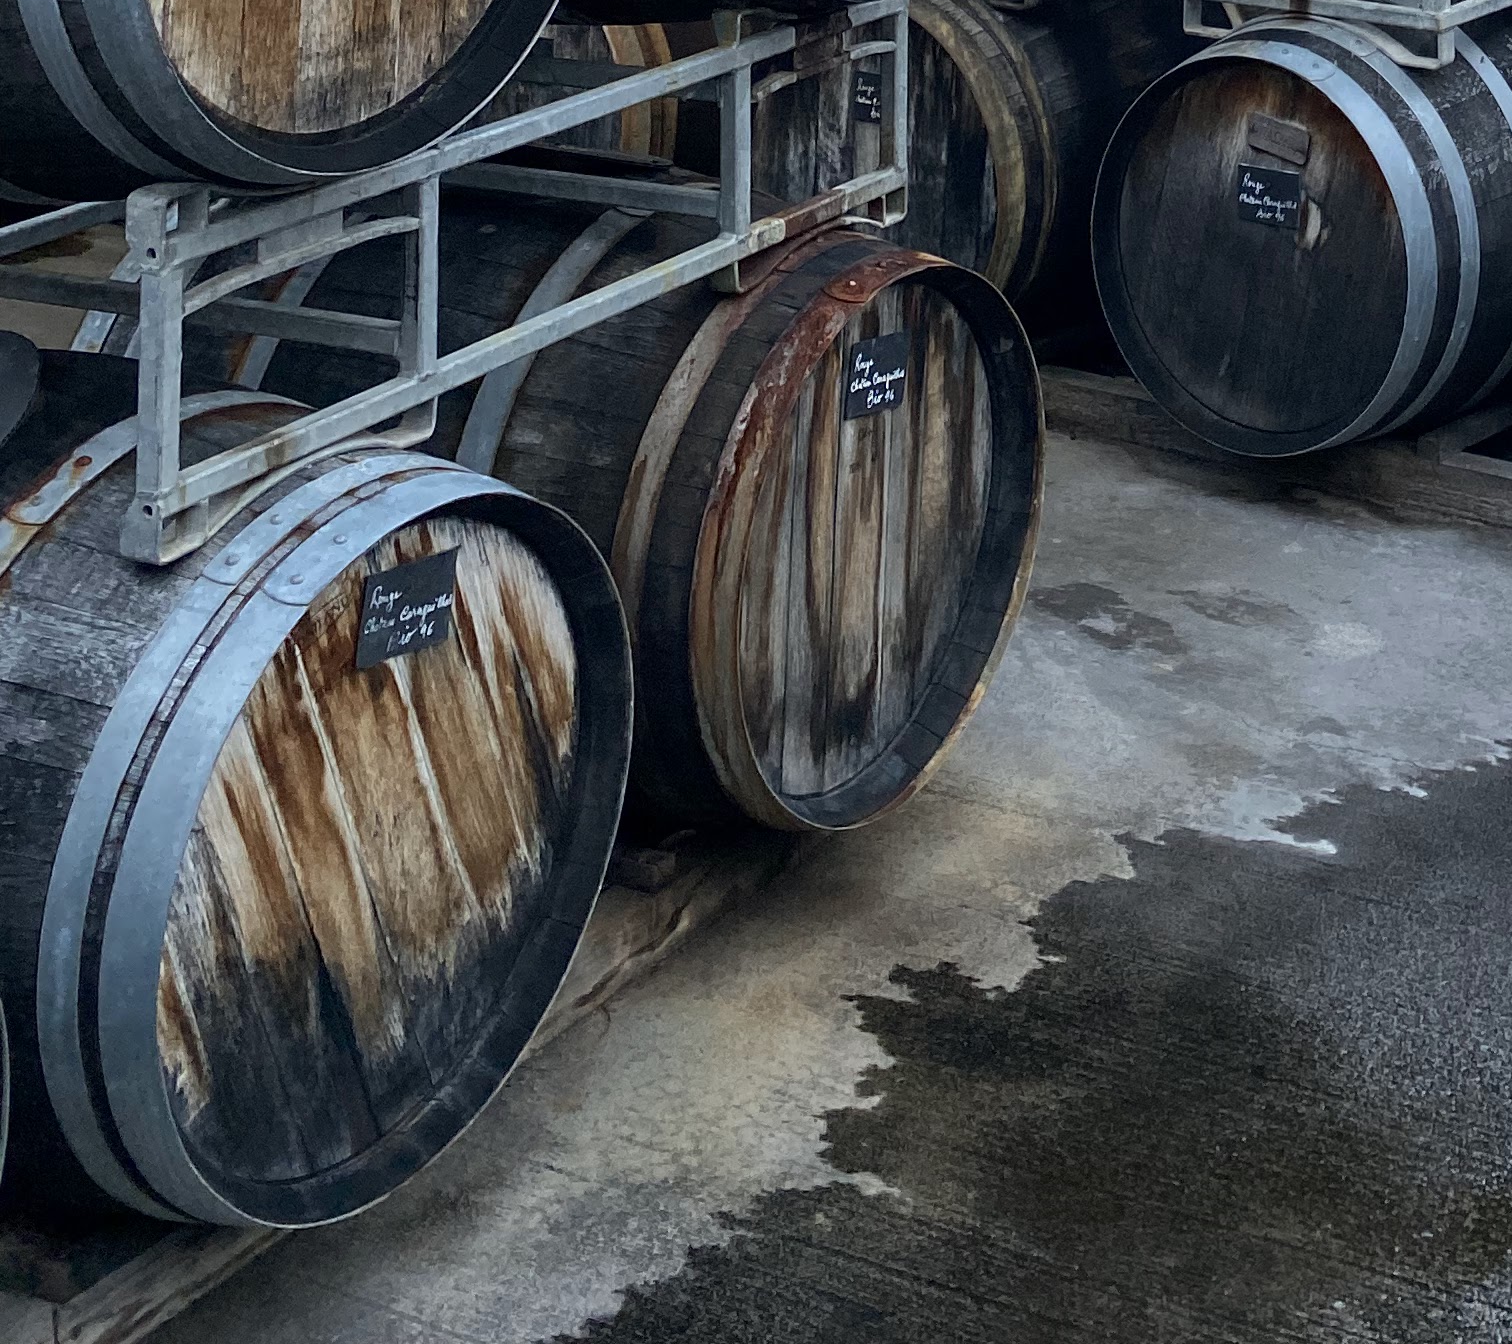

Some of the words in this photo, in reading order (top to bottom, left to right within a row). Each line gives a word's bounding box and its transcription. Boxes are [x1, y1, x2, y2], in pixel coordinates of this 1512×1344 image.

[1242, 172, 1265, 195] Rouge
[854, 352, 875, 379] Rouge
[370, 585, 403, 613] Rouge
